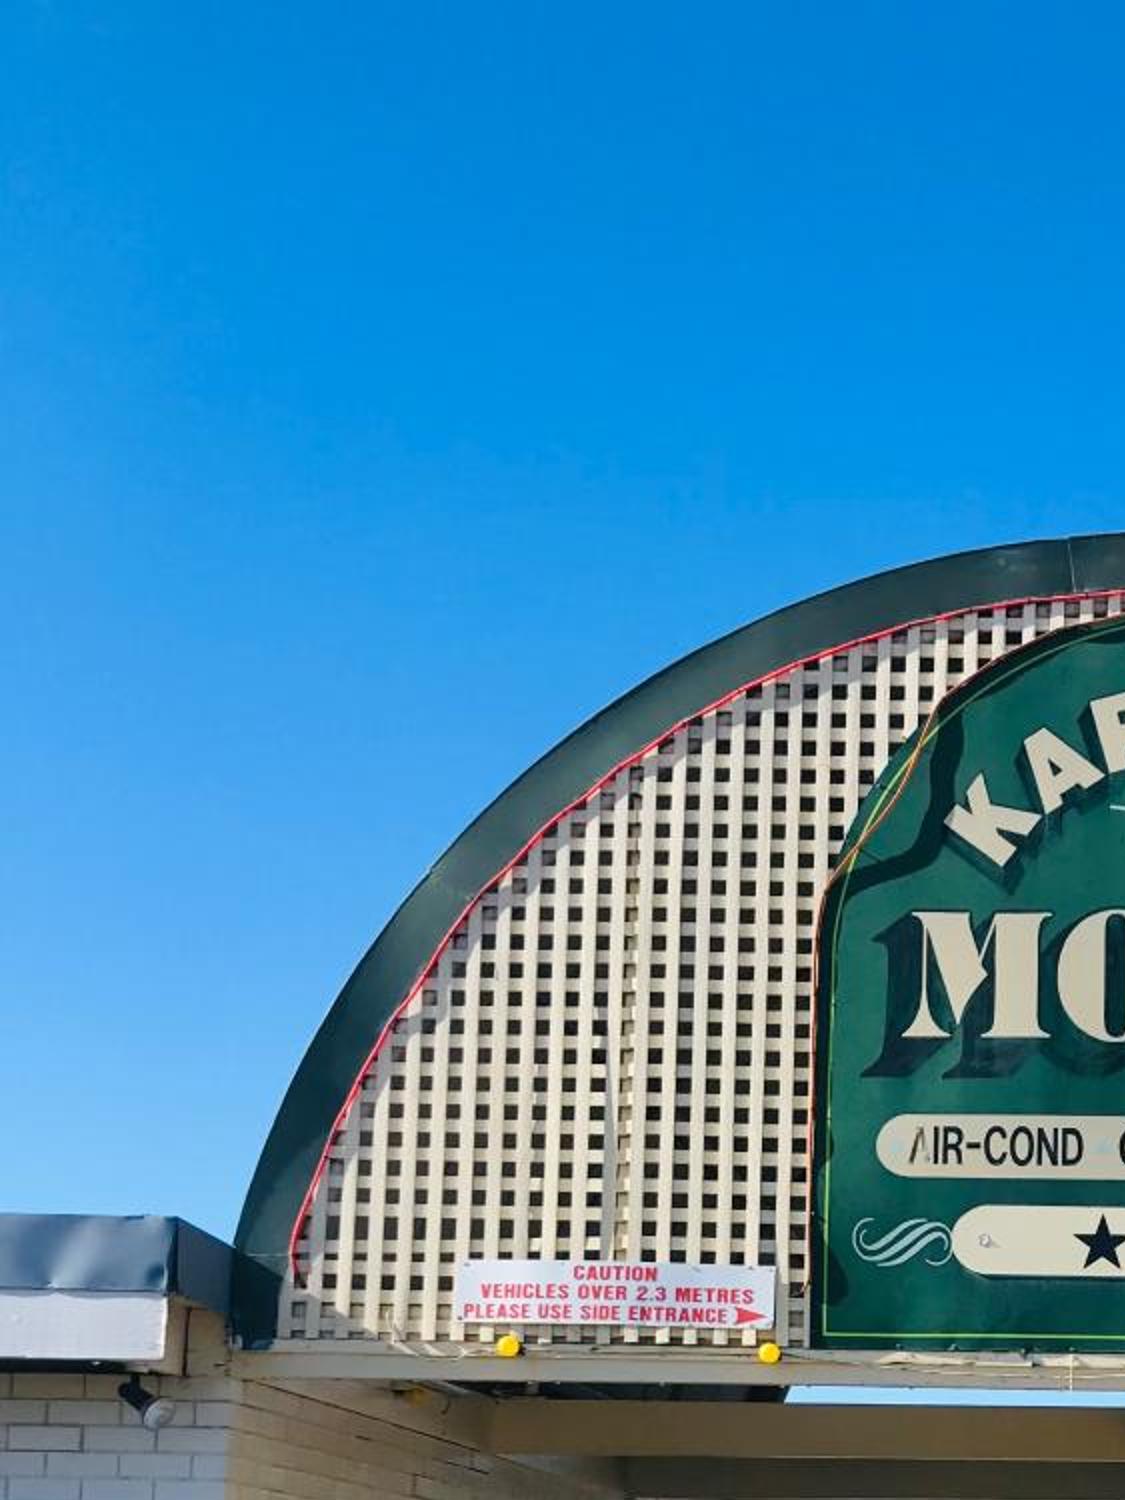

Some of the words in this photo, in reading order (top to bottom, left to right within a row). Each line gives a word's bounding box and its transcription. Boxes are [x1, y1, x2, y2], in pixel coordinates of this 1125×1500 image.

[908, 1125, 1084, 1168] AIR-COND
[573, 1265, 658, 1281] CAUTION
[480, 1283, 569, 1299] VEHICLES
[577, 1285, 627, 1301] OVER
[636, 1286, 667, 1301] 2.3
[675, 1287, 754, 1304] METRES
[463, 1303, 531, 1319] PLEASE
[537, 1303, 573, 1319] USE
[580, 1304, 621, 1321] SIDE
[628, 1306, 727, 1323] ENTRANCE
